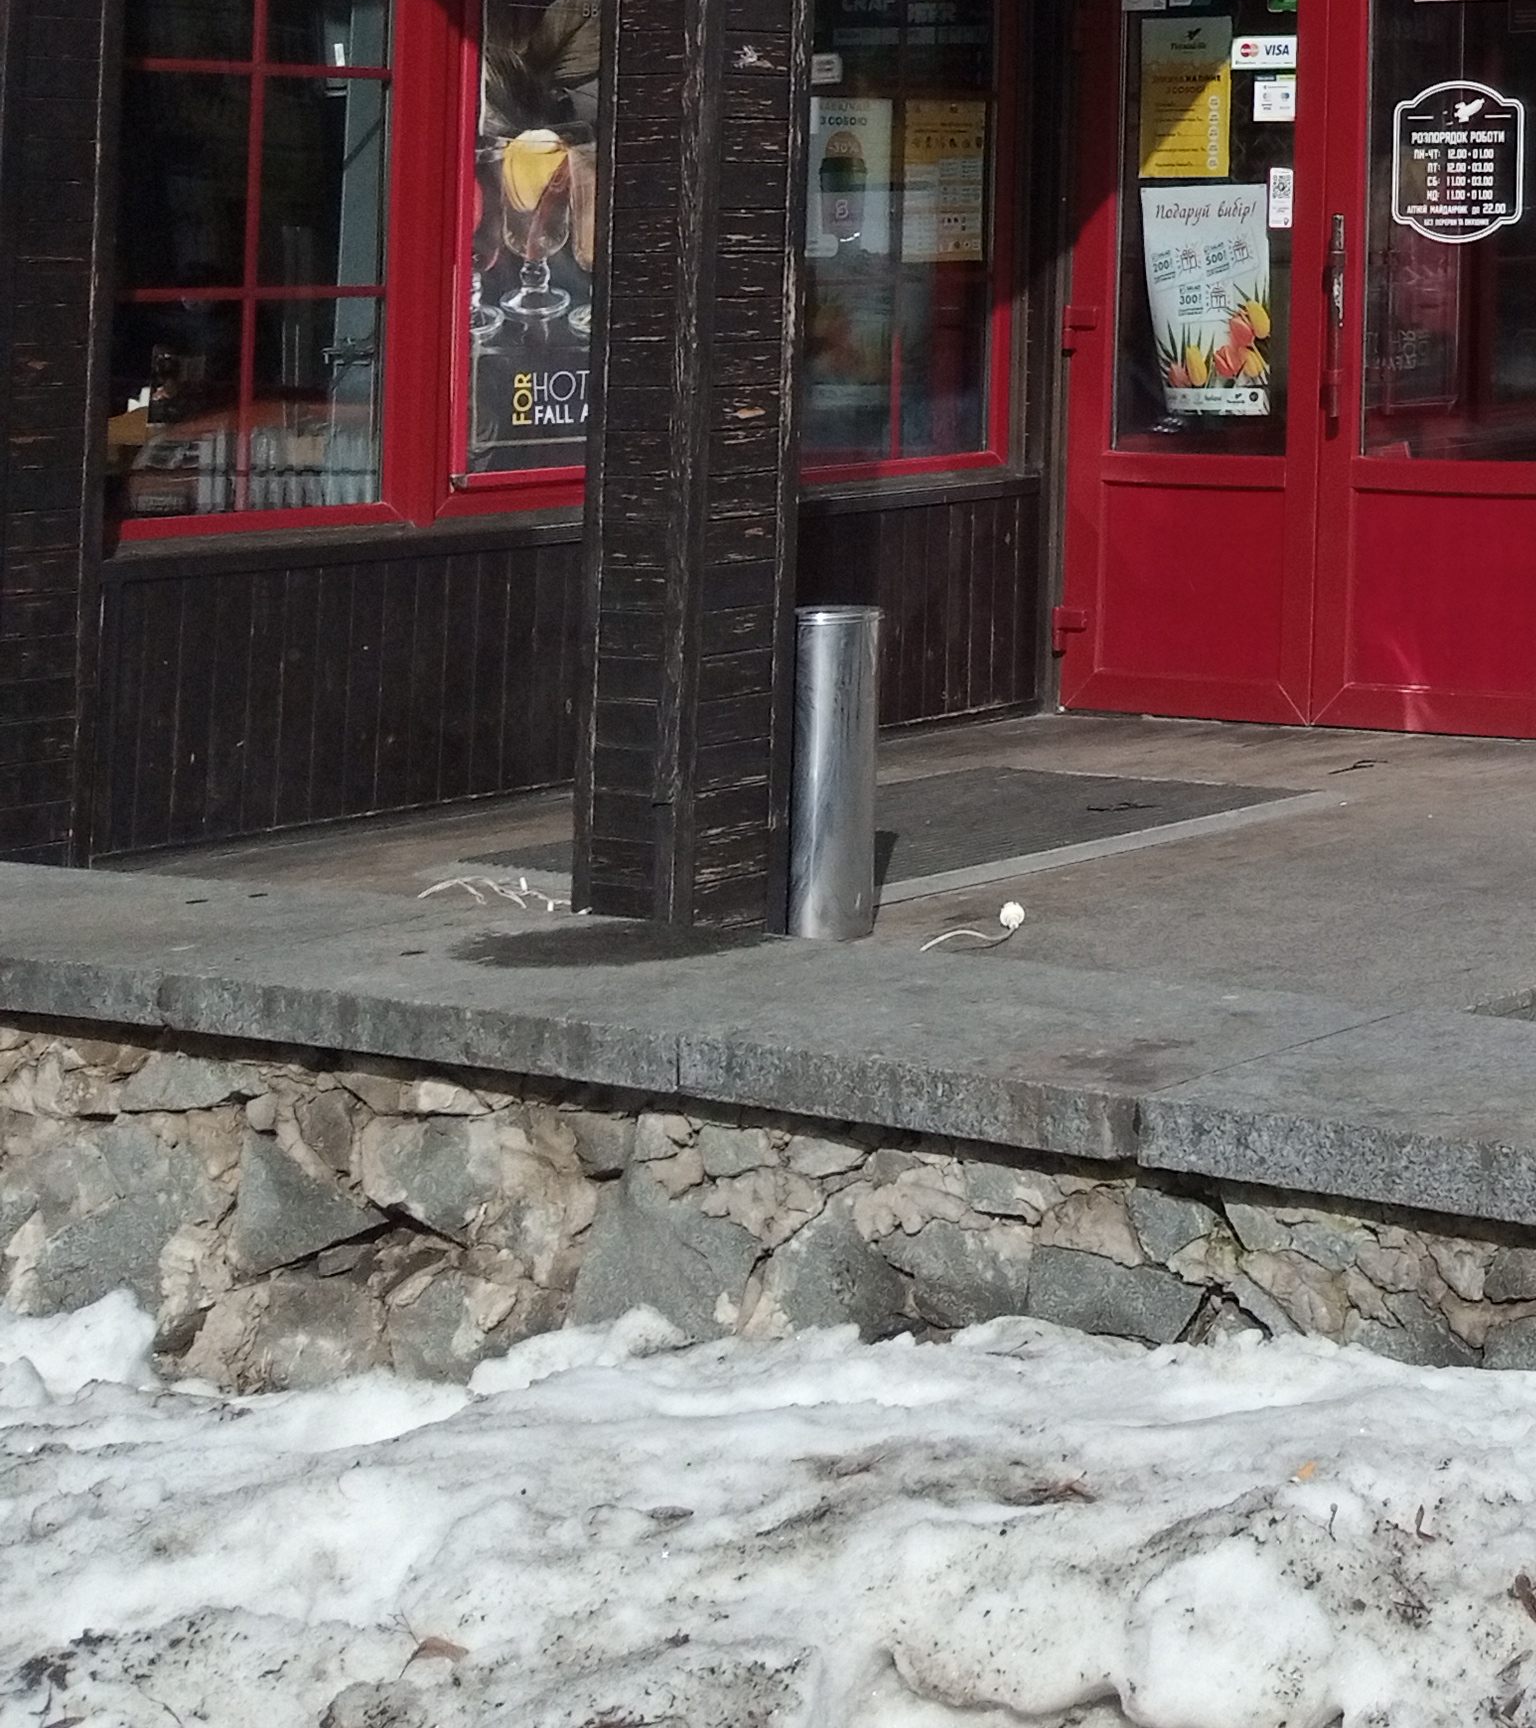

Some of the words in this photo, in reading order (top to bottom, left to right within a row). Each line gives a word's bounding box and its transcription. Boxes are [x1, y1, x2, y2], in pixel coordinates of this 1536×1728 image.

[582, 3, 600, 17] BB
[1264, 44, 1290, 56] VISA
[1411, 131, 1469, 145] РОЗПОРЯДОК
[1470, 130, 1505, 143] РОБОТИ
[1155, 203, 1211, 226] Подаруй
[1217, 197, 1257, 223] вибір!
[1482, 203, 1506, 214] 22.00
[533, 370, 590, 402] HOT
[512, 373, 533, 425] FOR
[534, 404, 574, 425] FALL
